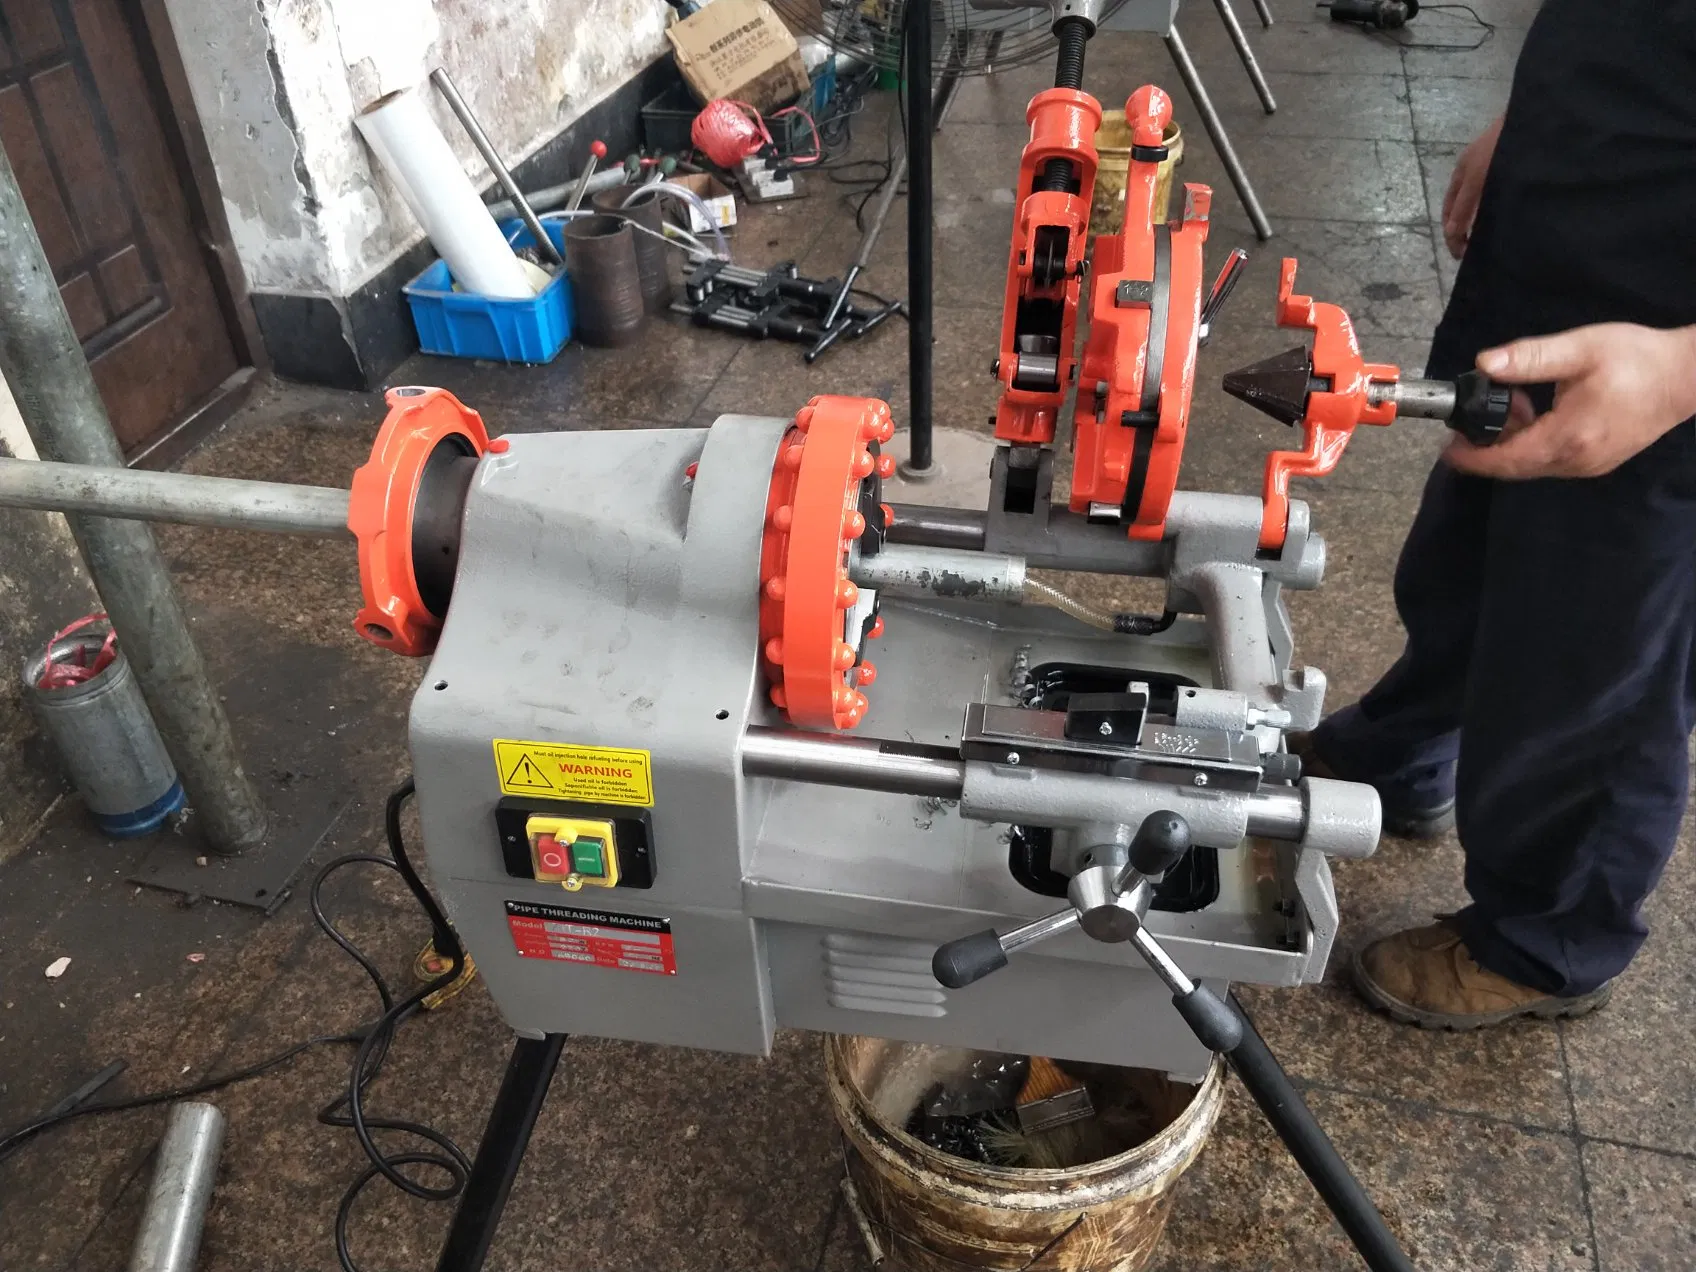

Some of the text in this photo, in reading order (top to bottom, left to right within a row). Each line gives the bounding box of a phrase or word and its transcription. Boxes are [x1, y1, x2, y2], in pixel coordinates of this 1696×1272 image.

[555, 752, 576, 760] injection
[558, 763, 633, 779] WARNING
[612, 786, 638, 794] forbidden
[512, 904, 662, 929] PIPE THREADING MACHINE
[511, 920, 543, 929] Model
